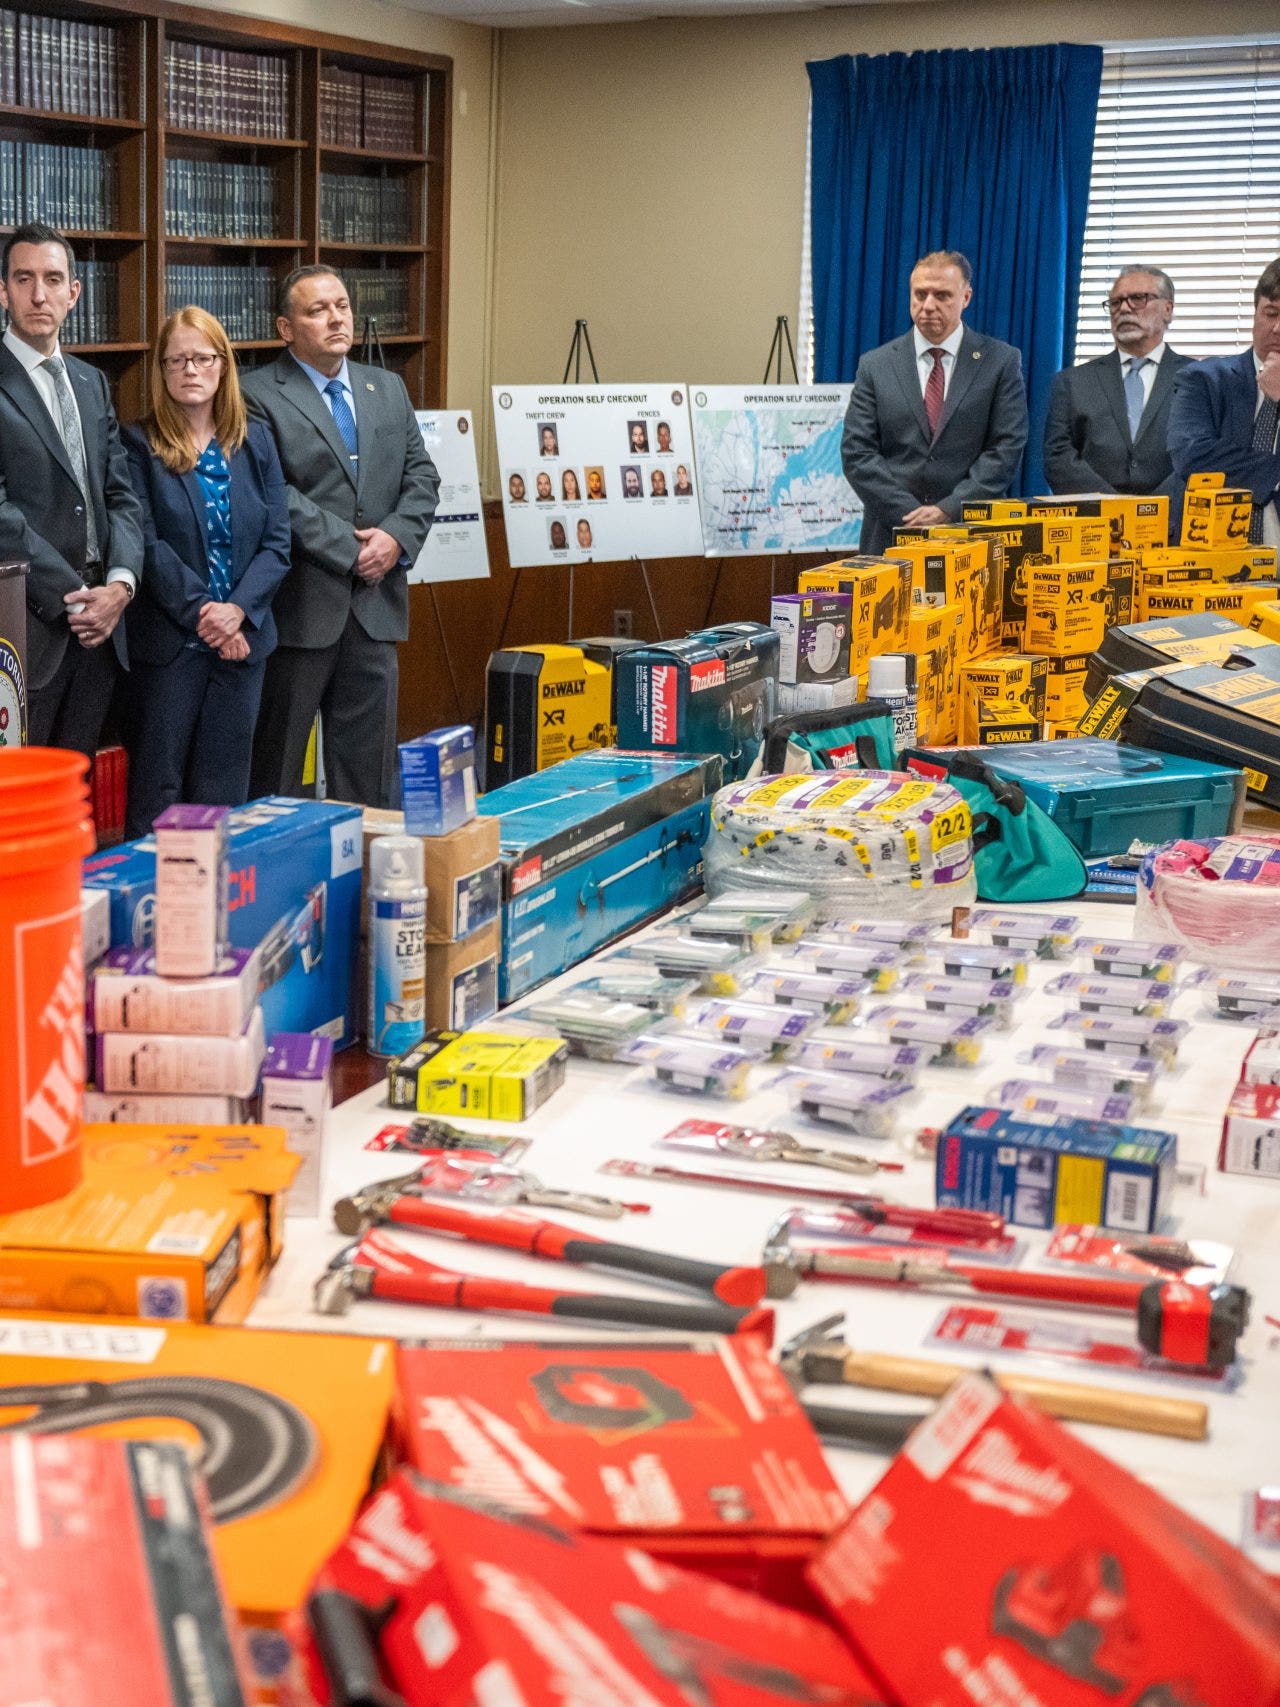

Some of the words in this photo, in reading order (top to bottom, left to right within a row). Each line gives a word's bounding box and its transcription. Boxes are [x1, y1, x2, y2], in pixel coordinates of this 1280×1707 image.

[538, 396, 583, 404] OPERATION
[607, 394, 647, 403] CHECKOUT
[744, 395, 784, 403] OPERATION
[786, 395, 802, 403] SELF
[805, 394, 841, 403] CHECKOUT
[525, 412, 545, 420] THEFT
[637, 410, 661, 418] FENCES
[964, 510, 987, 520] DEWALT
[1034, 573, 1060, 581] DEWALT
[1067, 570, 1095, 584] DEWALT
[1067, 590, 1083, 605] XR
[1149, 595, 1193, 609] DEWALT
[1205, 595, 1243, 609] DEWALT
[691, 669, 726, 692] Makita
[967, 673, 1000, 683] DEWALT
[542, 679, 585, 698] DEWALT
[651, 666, 668, 744] Makita
[1081, 686, 1121, 734] DEWALT
[543, 709, 565, 726] XR
[1099, 706, 1128, 739] ATOMIC
[987, 730, 1032, 743] DEWALT
[938, 813, 965, 839] 12/2
[910, 863, 922, 880] 12/2
